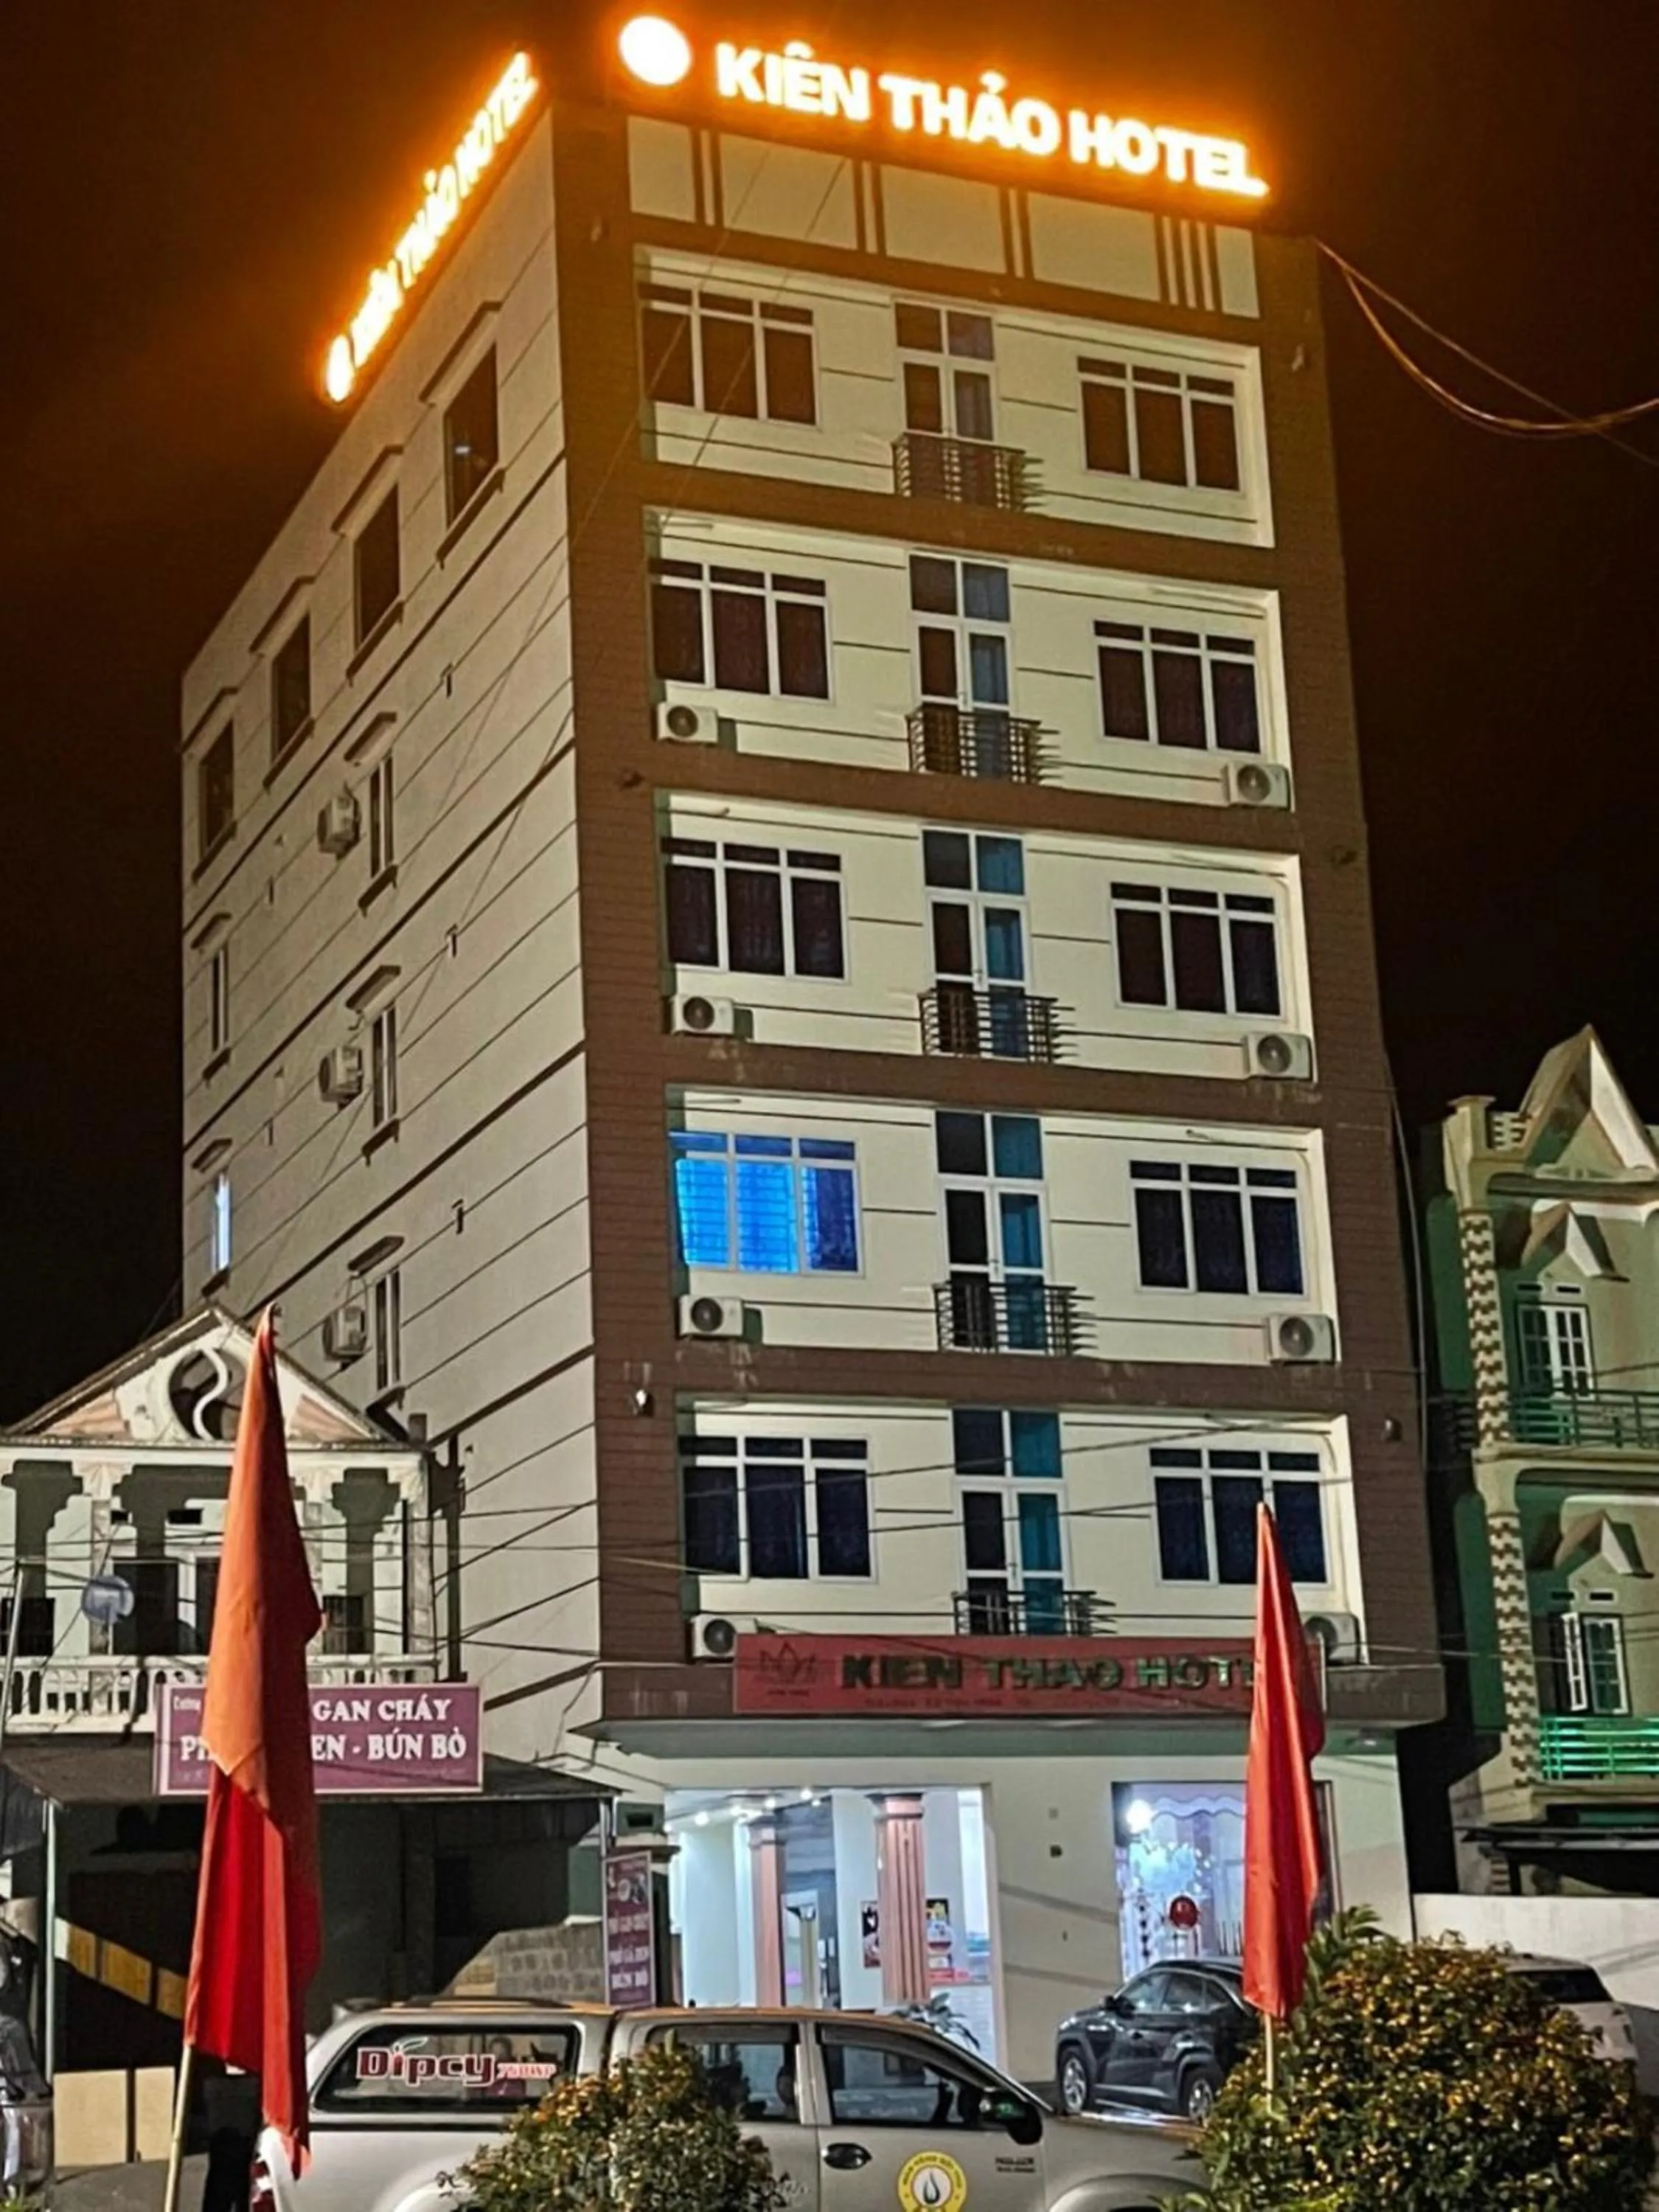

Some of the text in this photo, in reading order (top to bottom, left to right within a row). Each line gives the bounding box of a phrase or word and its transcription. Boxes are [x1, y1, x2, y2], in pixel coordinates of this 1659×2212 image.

[715, 41, 1270, 197] KIÊN THẢO HOTEL
[1135, 1654, 1254, 1691] HOT
[312, 1693, 451, 1722] GAN CHÁY
[367, 1726, 423, 1761] BÚN
[431, 1725, 467, 1761] BÒ
[357, 2037, 495, 2086] Dipcy
